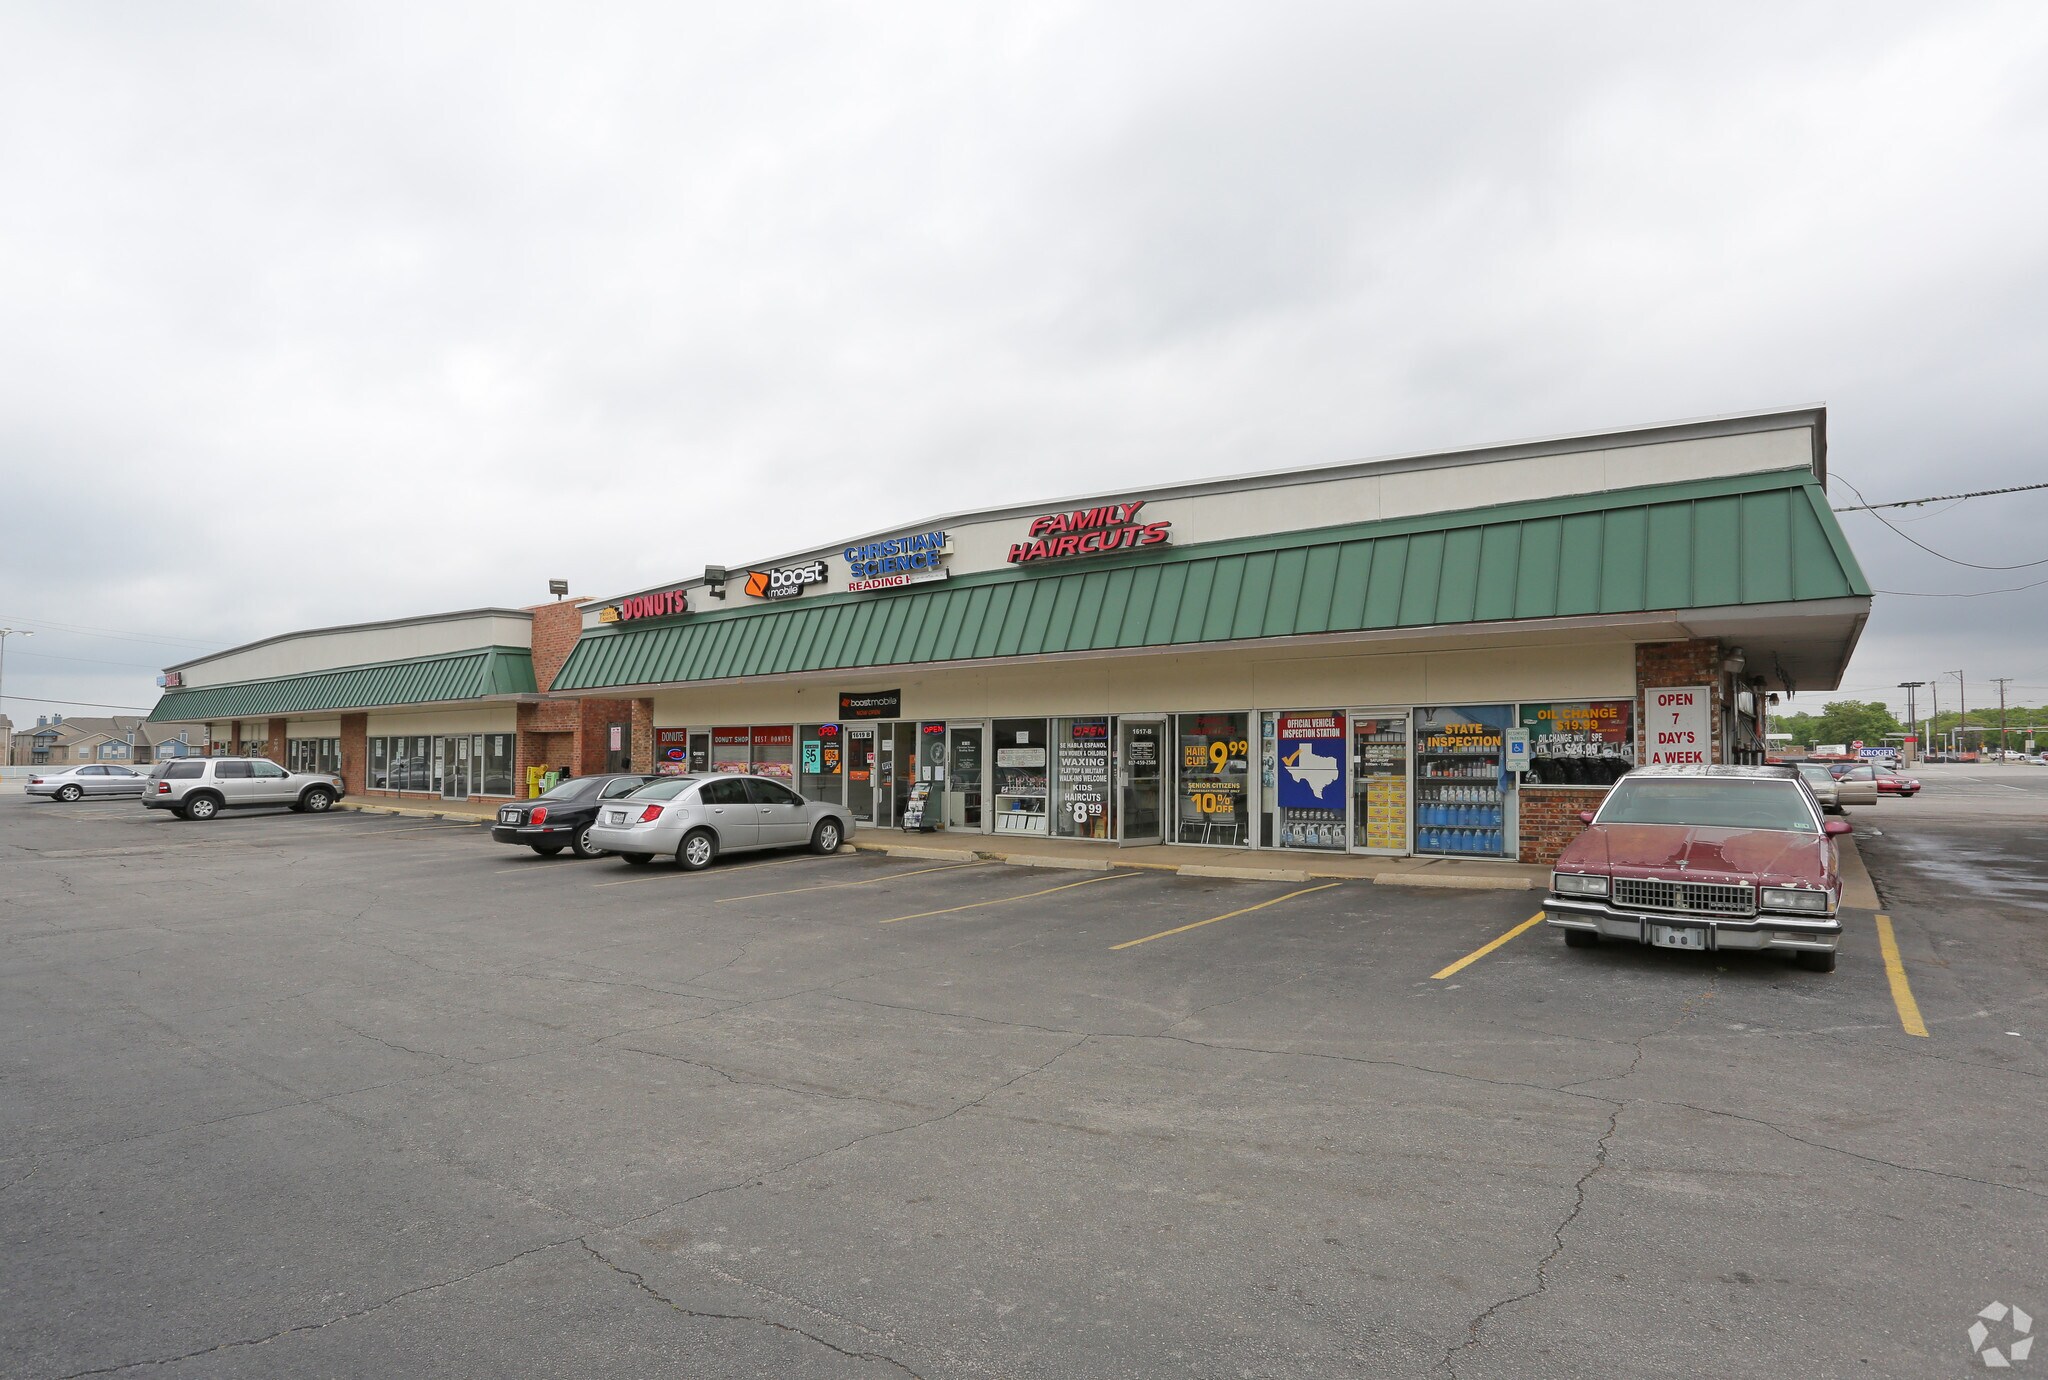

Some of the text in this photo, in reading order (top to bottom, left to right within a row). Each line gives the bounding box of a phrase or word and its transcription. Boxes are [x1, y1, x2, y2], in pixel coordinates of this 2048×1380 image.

[1029, 500, 1144, 537] FAMILY
[843, 531, 945, 562] CHRISTIAN
[1007, 521, 1172, 563] HAIRCUTS
[850, 549, 941, 578] SCIENCE
[770, 561, 823, 588] boost
[848, 576, 903, 592] READING
[770, 585, 799, 598] mobile
[623, 589, 686, 620] DONUTS
[1658, 693, 1693, 706] OPEN
[1537, 708, 1618, 719] OIL CHANGE
[1672, 713, 1679, 724] 7
[1287, 718, 1335, 728] OFFICIAL VEHICLE
[1445, 723, 1483, 734] STATE
[1556, 720, 1598, 731] $19.99
[924, 725, 943, 734] OPEN
[1073, 726, 1106, 737] OPEN
[1282, 728, 1340, 738] INSPECTION STATION
[662, 731, 684, 742] DONUTS
[755, 735, 791, 743] BEST DONUTS
[1427, 735, 1501, 747] INSPECTION
[1538, 734, 1549, 742] OIL
[1549, 733, 1572, 742] CHANGE
[1591, 733, 1603, 742] SPE
[1658, 731, 1695, 744] DAY'S
[1186, 747, 1206, 756] HAIR
[1565, 743, 1598, 755] $24.99
[1860, 749, 1895, 757] KROGER
[805, 749, 817, 762] $5
[1186, 757, 1205, 765] CUT
[1652, 751, 1703, 764] A WEEK
[1061, 758, 1105, 766] WAXING
[1065, 793, 1101, 802] HAIRCUTS
[1191, 793, 1234, 813] 10% OFF
